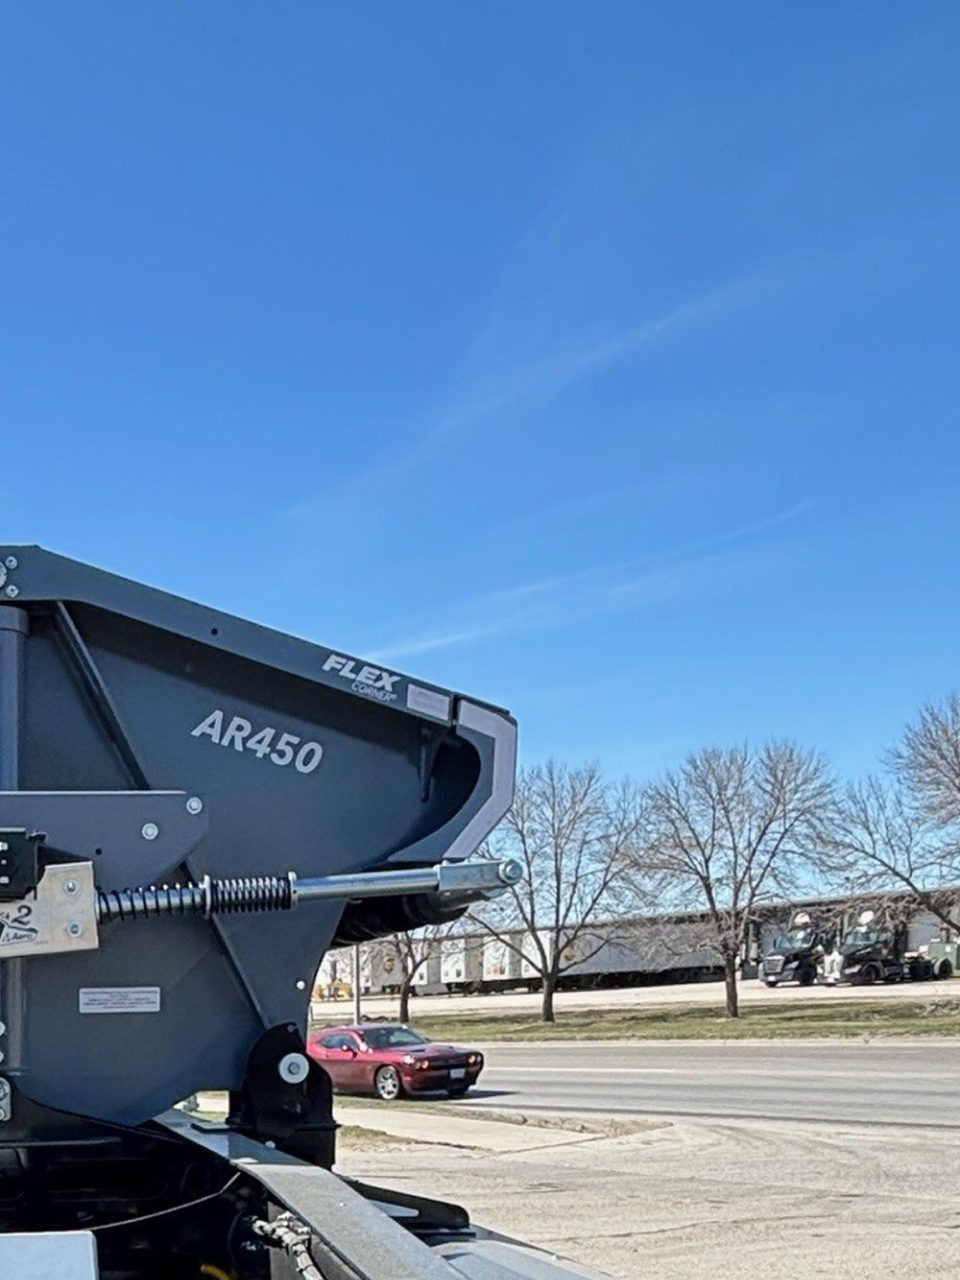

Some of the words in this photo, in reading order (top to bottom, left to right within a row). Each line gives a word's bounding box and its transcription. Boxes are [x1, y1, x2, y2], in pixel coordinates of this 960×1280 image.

[322, 654, 402, 692] FLEX
[191, 709, 323, 774] AR450
[11, 904, 32, 925] 2
